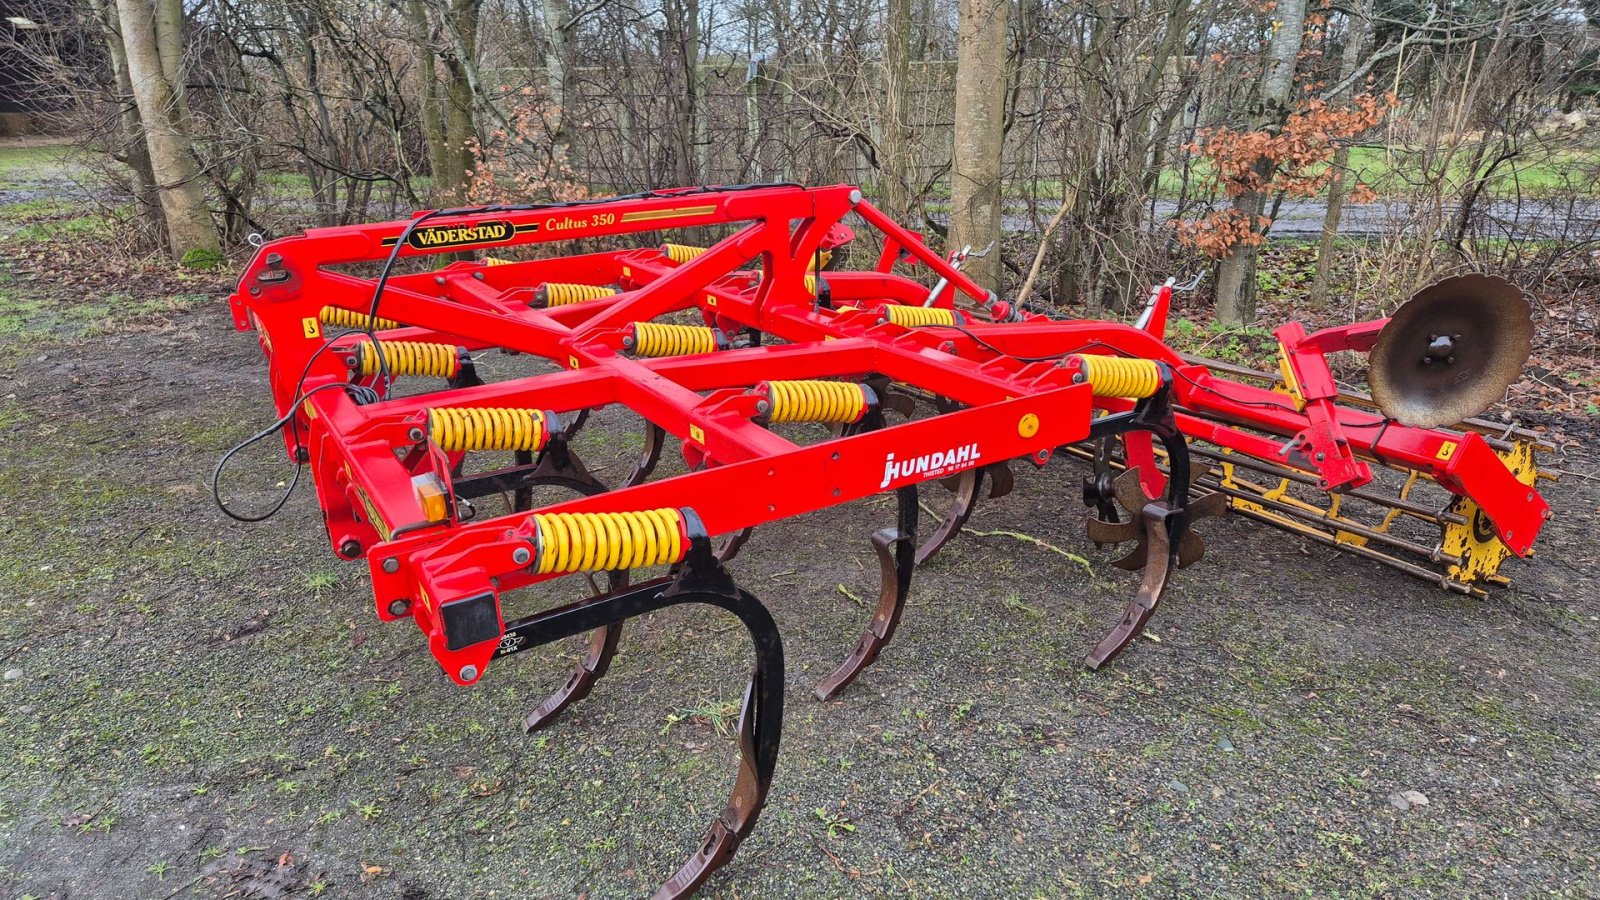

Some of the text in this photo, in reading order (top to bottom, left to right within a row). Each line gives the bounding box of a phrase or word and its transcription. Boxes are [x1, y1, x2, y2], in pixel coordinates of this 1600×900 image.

[417, 213, 615, 246] VÄDERSTAD Cultus 350
[923, 468, 945, 478] THISTED
